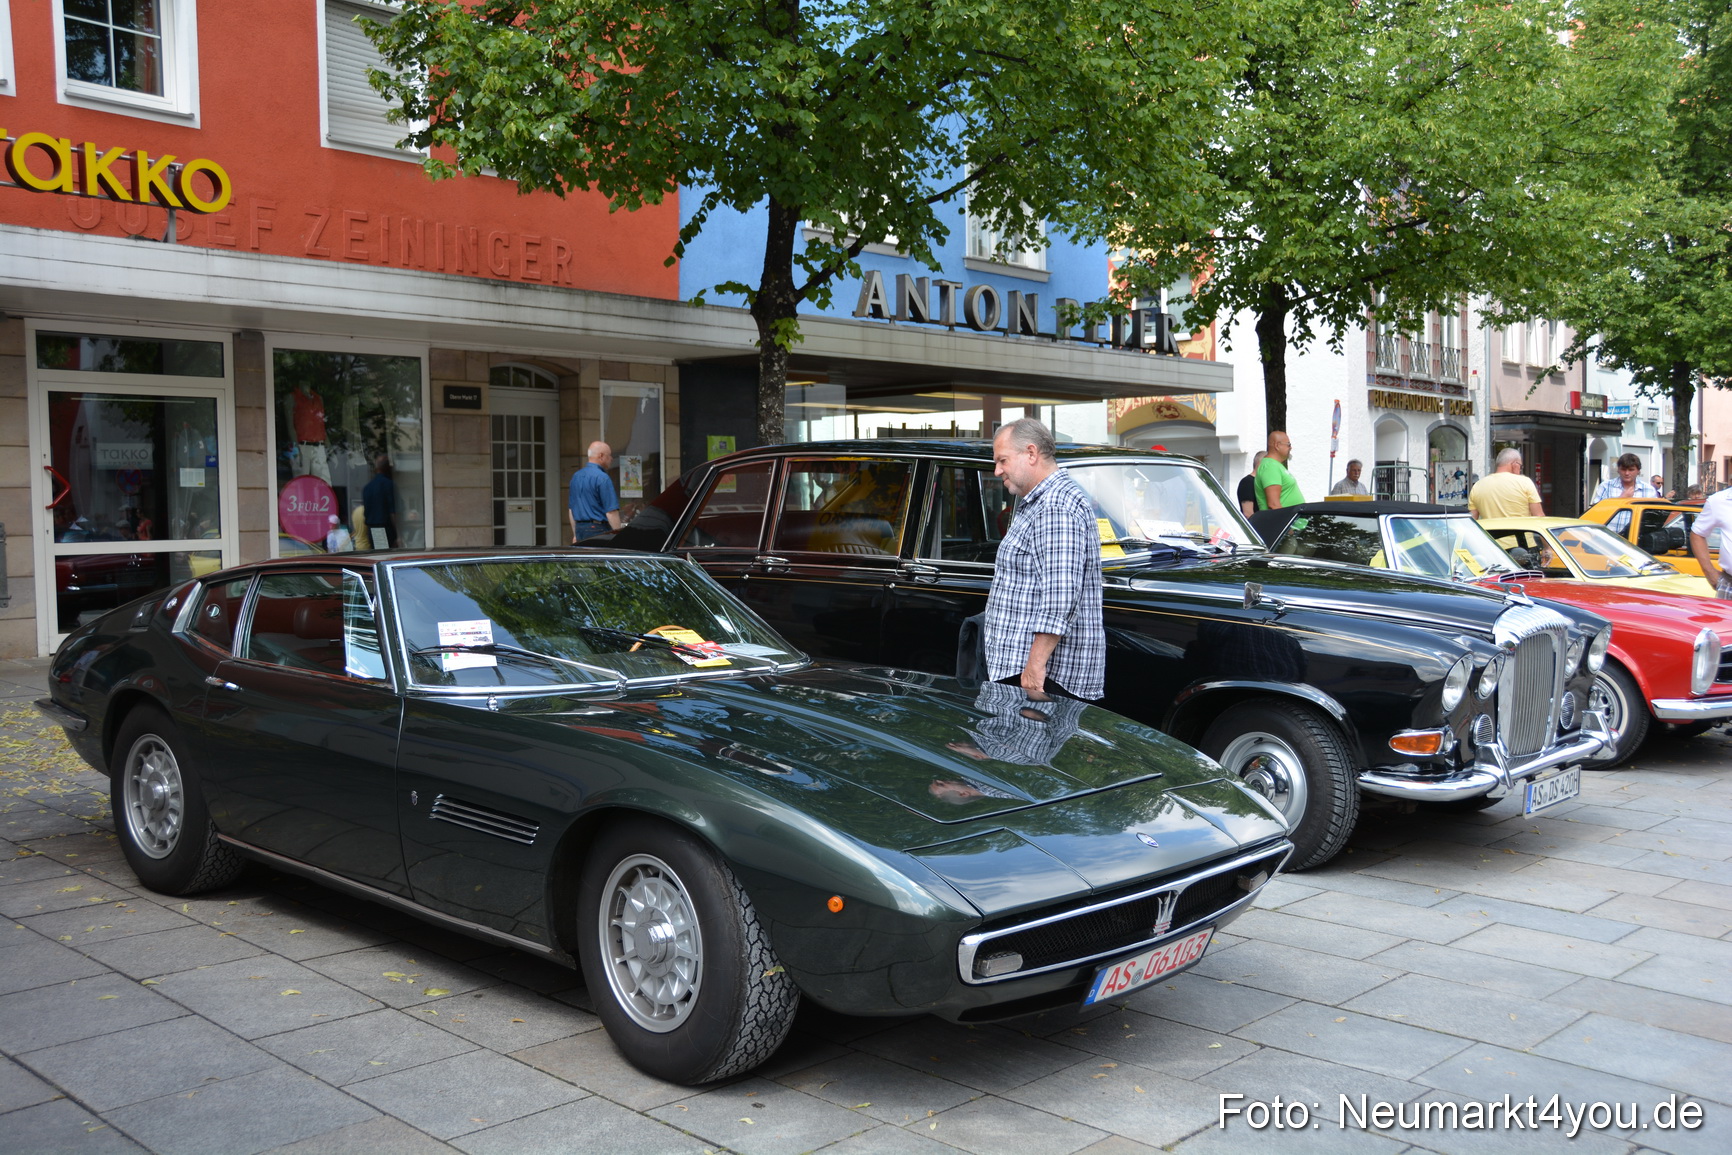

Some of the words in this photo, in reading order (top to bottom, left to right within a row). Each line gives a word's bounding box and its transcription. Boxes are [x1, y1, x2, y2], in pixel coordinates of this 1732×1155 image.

[0, 128, 231, 213] akko
[304, 207, 572, 284] ZEININGER
[853, 270, 1038, 335] ANTON
[1374, 390, 1444, 413] BUCHHANDLUNG
[287, 495, 298, 512] 3
[298, 501, 319, 512] FÜR
[320, 495, 330, 512] 2
[1532, 784, 1543, 807] AS
[1548, 778, 1559, 801] DS
[1101, 961, 1137, 996] AS
[1143, 932, 1208, 981] 06103
